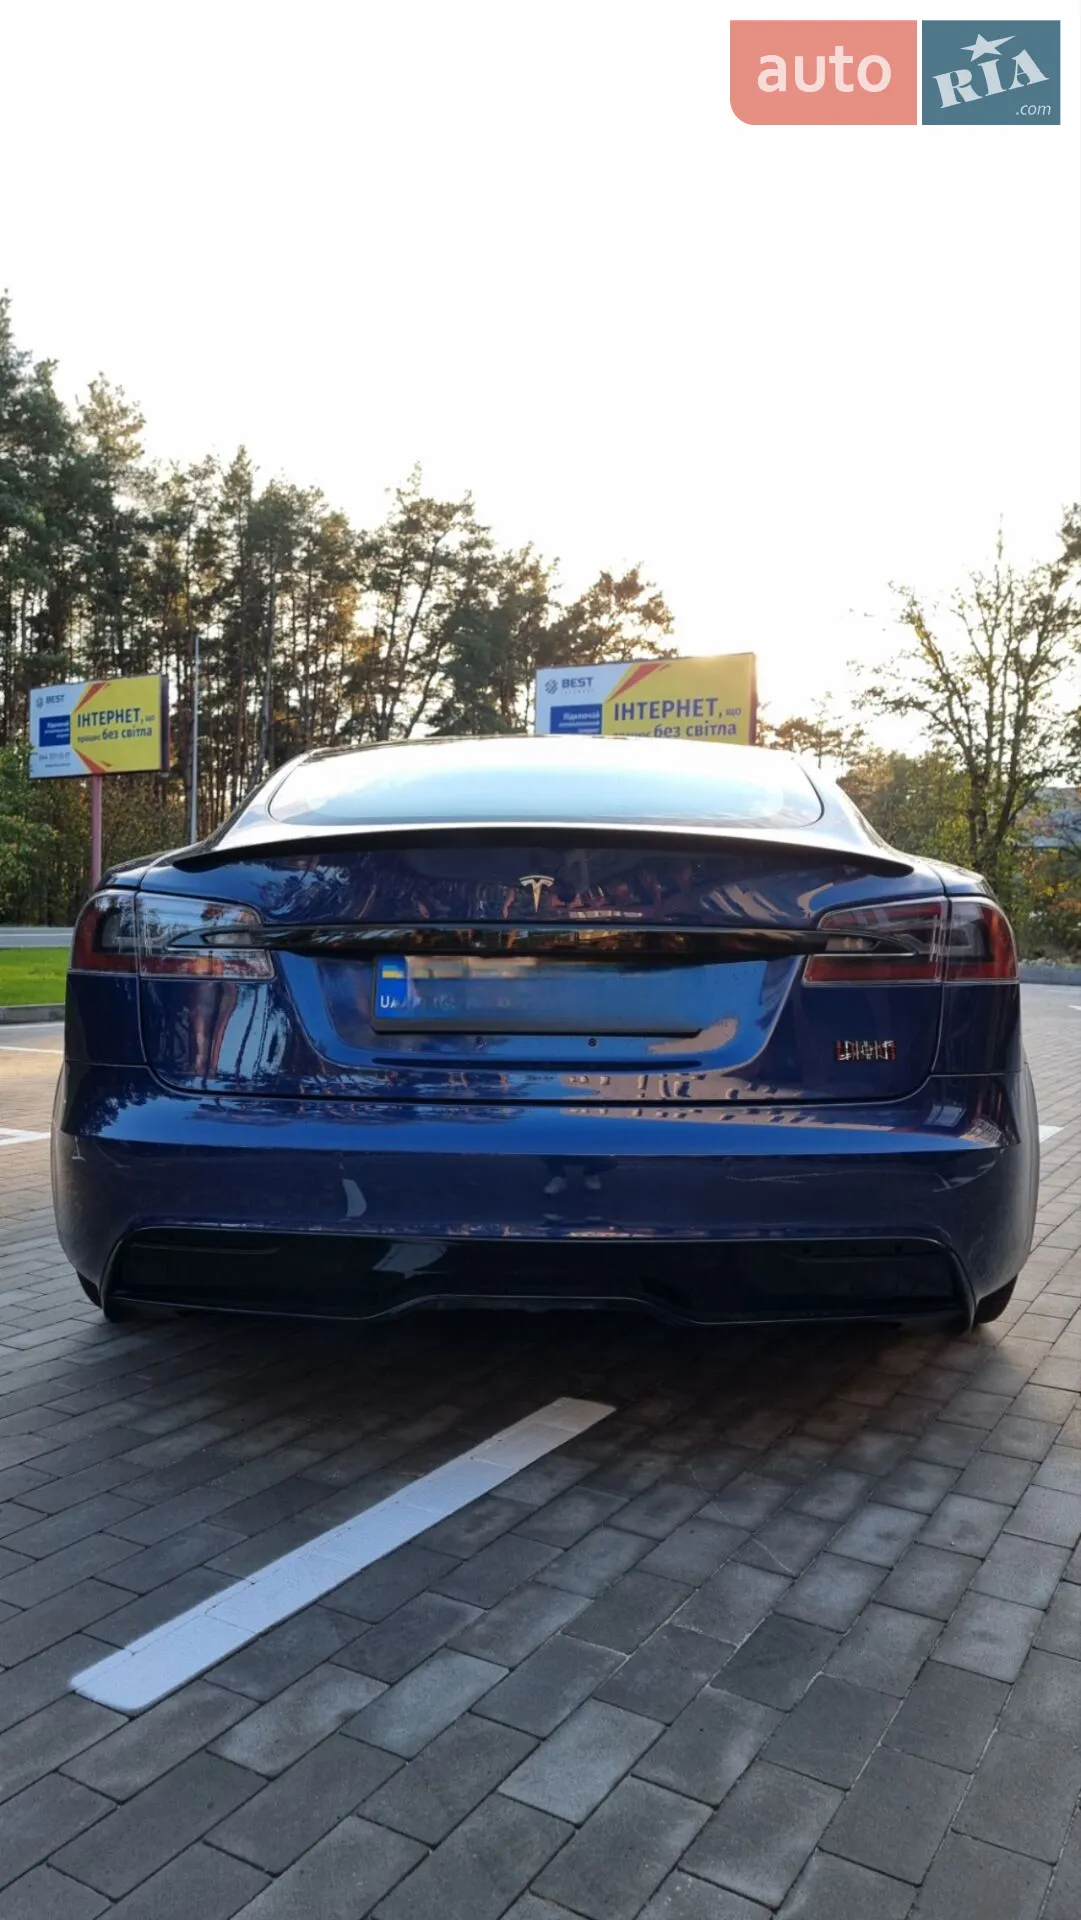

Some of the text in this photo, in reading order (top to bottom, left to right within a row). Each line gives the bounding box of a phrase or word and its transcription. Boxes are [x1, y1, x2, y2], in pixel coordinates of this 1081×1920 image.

[562, 676, 594, 688] BEST
[46, 694, 65, 704] BEST
[77, 707, 143, 728] ІНТЕРНЕТ,
[614, 698, 723, 721] ІНТЕРНЕТ,
[102, 727, 119, 740] без
[121, 724, 153, 739] світла
[654, 723, 681, 738] без
[686, 720, 737, 737] світла
